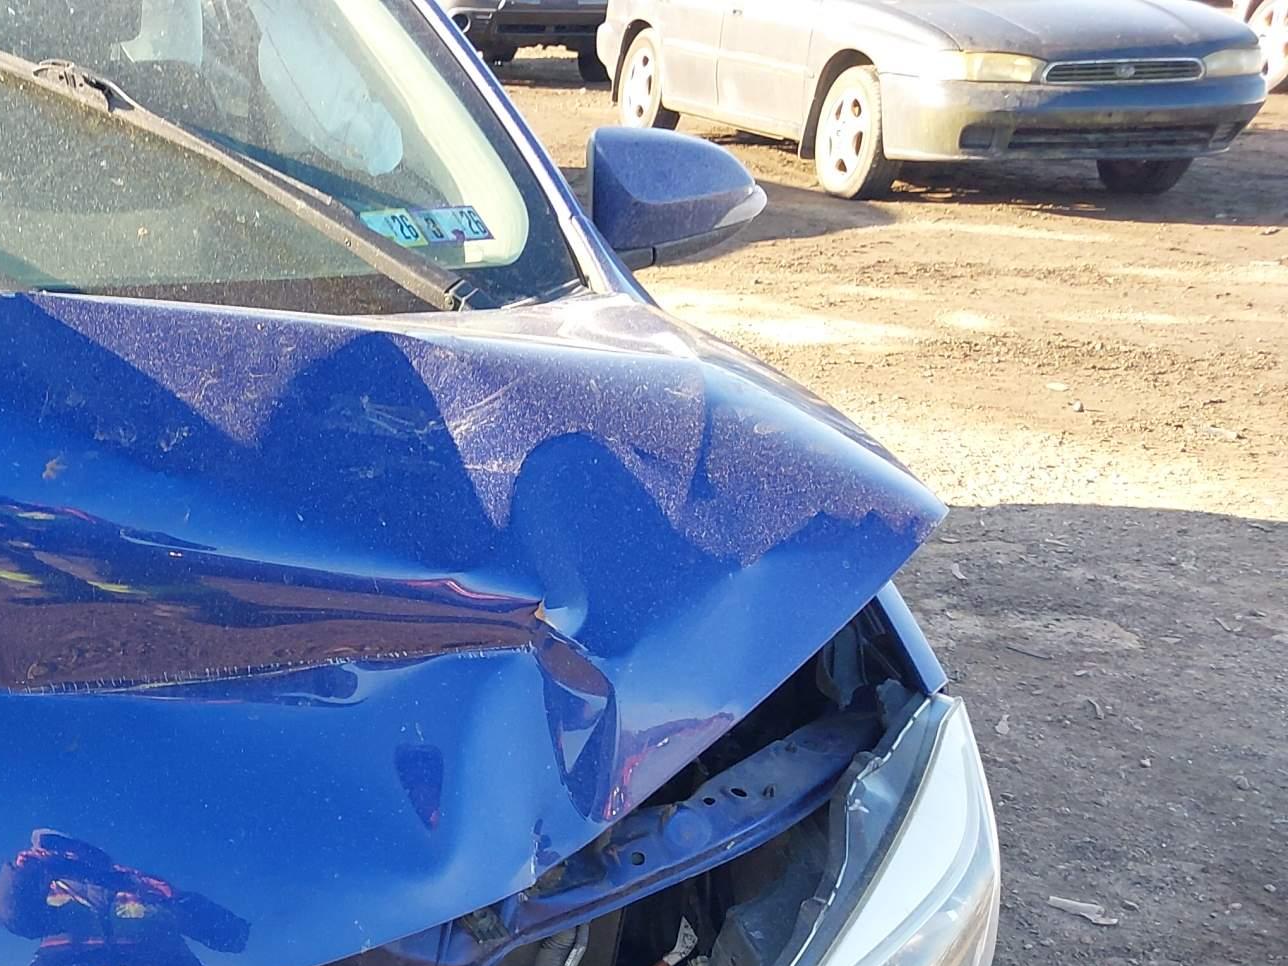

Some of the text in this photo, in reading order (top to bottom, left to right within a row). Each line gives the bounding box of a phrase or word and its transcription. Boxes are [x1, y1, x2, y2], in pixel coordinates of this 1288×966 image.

[390, 214, 420, 240] 26
[423, 216, 445, 239] 3
[459, 210, 487, 235] 26
